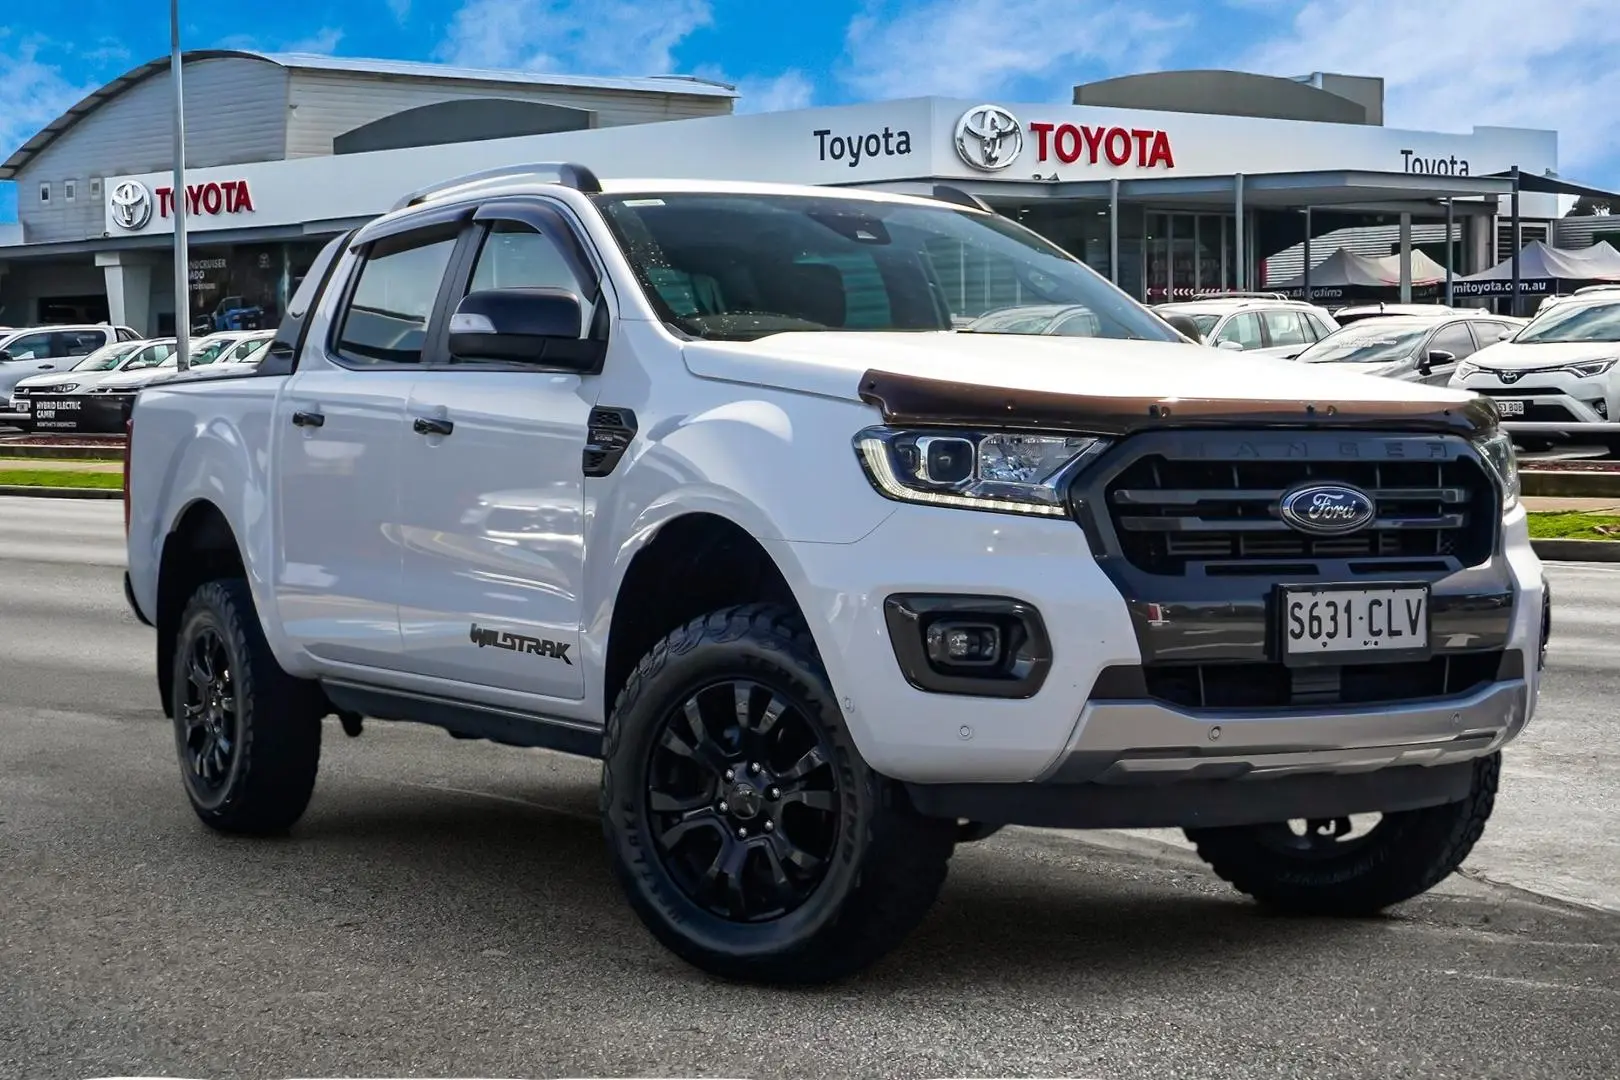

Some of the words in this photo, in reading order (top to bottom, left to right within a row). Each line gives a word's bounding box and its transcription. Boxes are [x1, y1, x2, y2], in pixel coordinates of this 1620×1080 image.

[813, 128, 912, 168] Toyota
[1030, 122, 1174, 168] TOYOTA
[1453, 281, 1546, 295] mitoyota.cm.au
[36, 401, 56, 410] HYBRID
[56, 401, 81, 410] ELECTRIC
[36, 410, 56, 419] CAMRY
[1308, 493, 1357, 519] Ford
[469, 623, 573, 666] WILDTRAK
